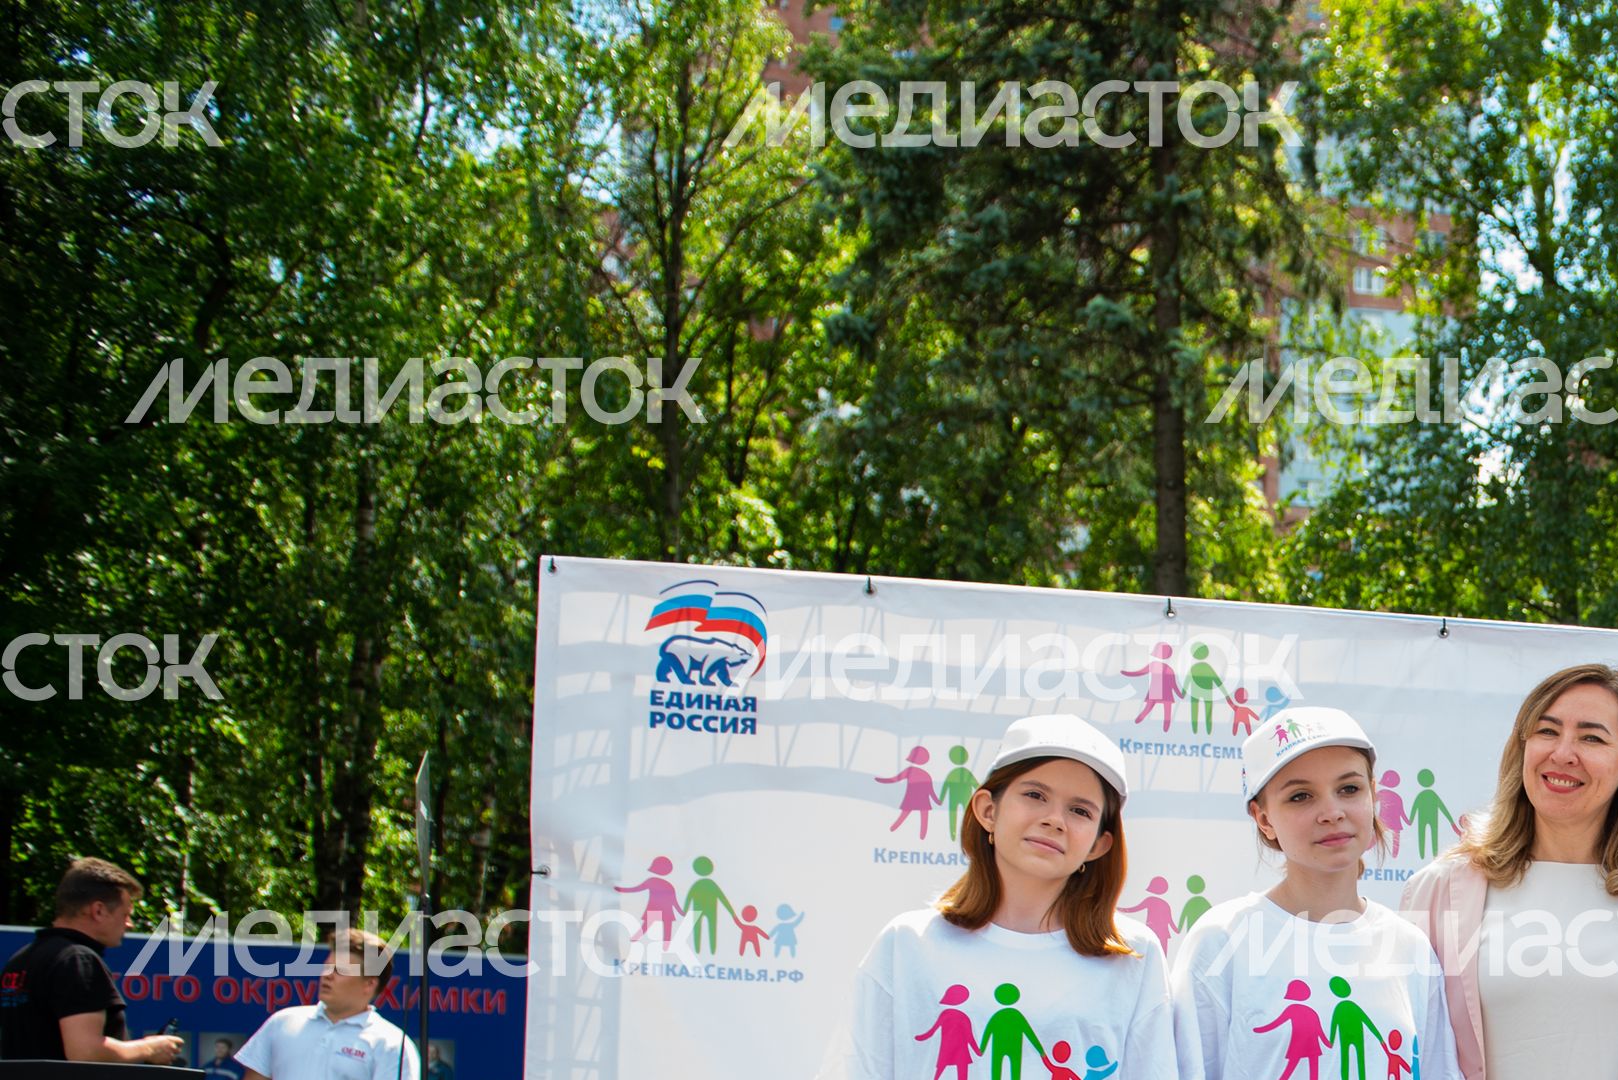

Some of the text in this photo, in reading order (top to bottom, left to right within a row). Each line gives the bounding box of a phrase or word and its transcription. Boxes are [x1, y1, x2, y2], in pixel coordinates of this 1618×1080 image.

[650, 690, 757, 712] ЕДИНАЯ
[650, 711, 757, 735] РОССИЯ
[874, 847, 969, 867] КРЕПКАЯС
[112, 971, 506, 1016] ого окру Химки
